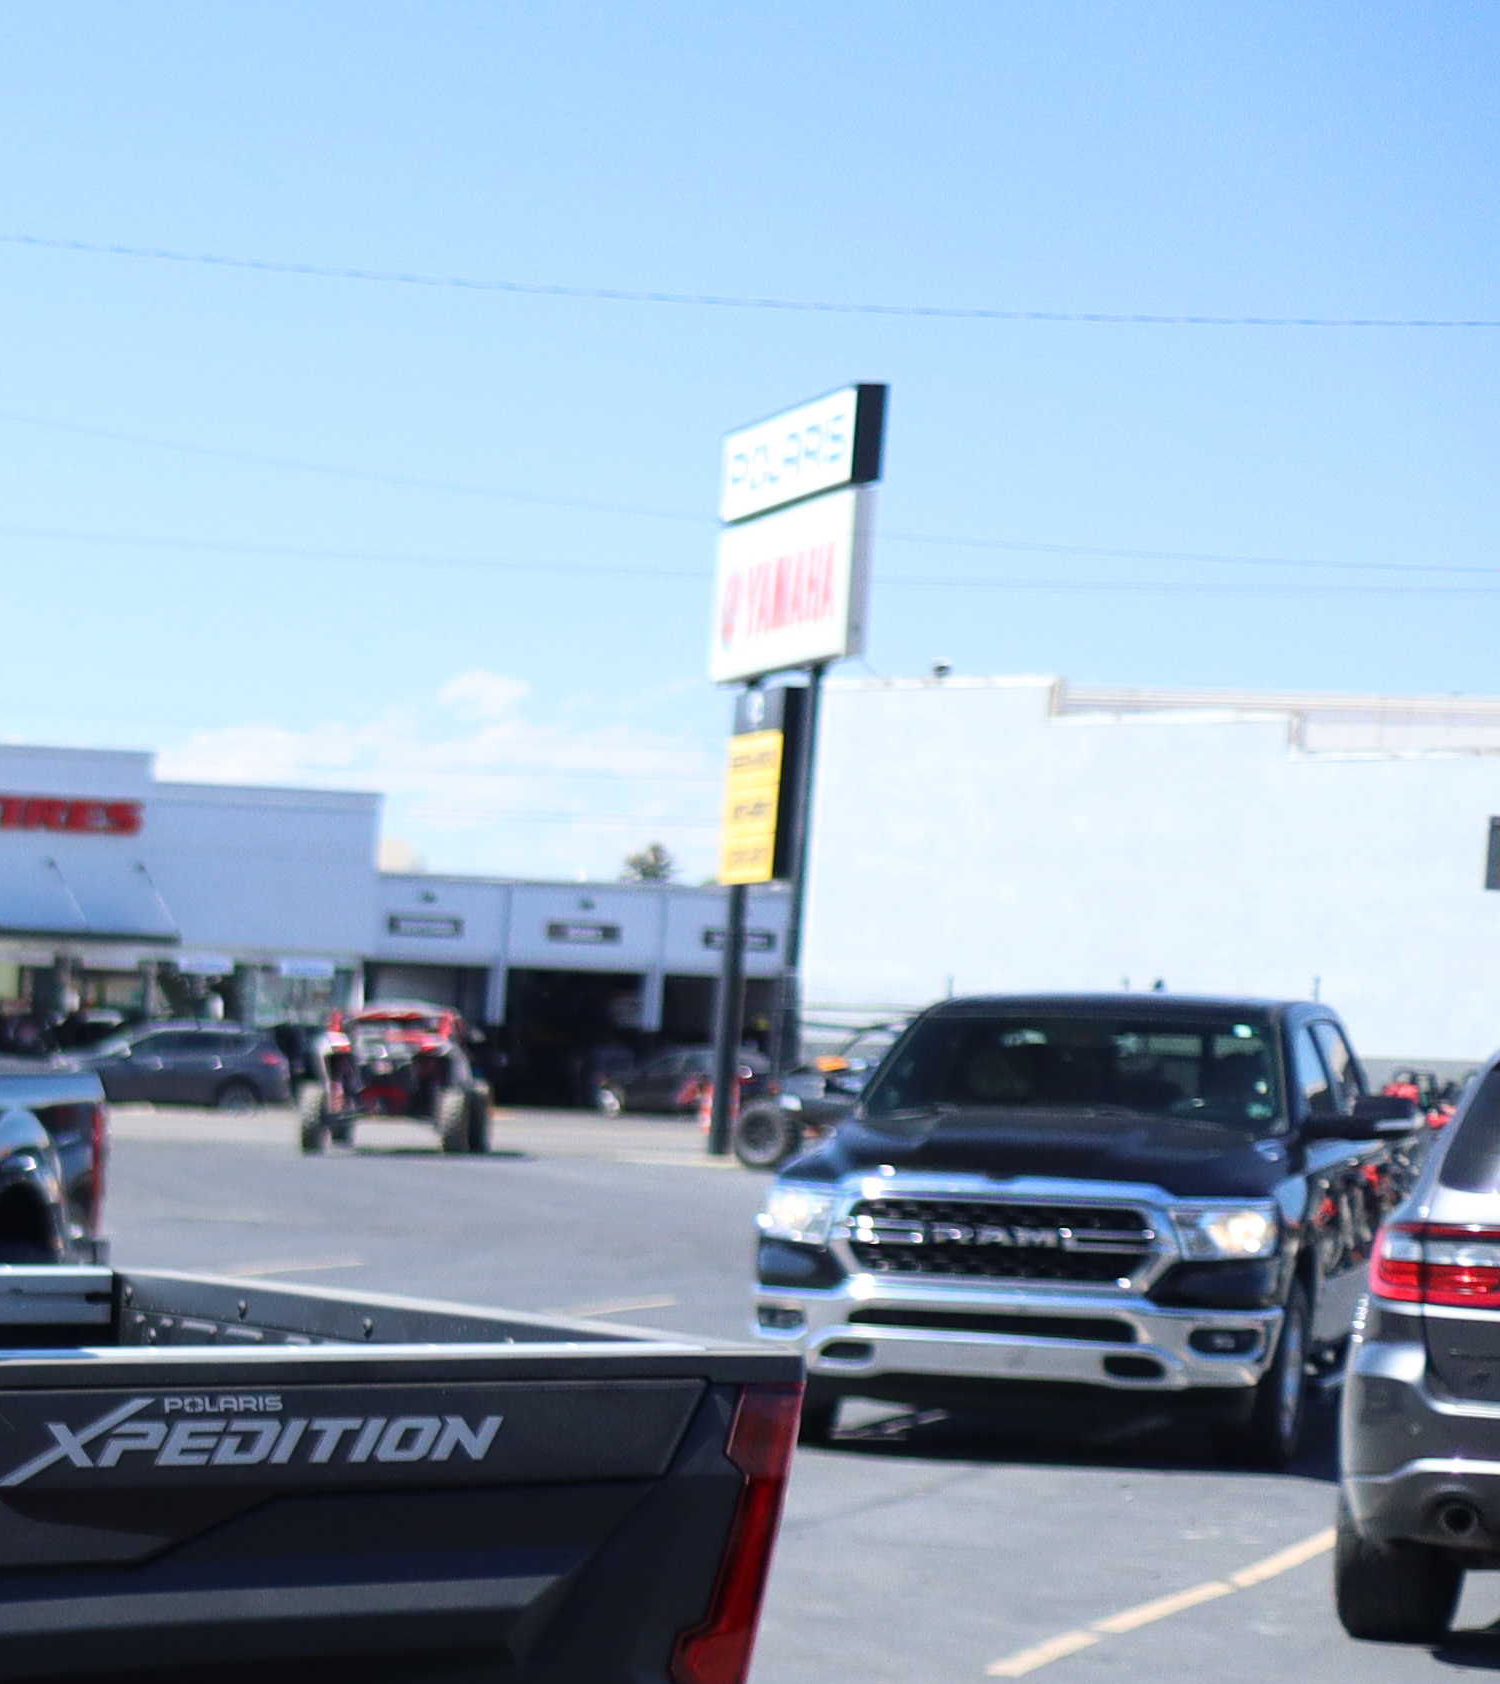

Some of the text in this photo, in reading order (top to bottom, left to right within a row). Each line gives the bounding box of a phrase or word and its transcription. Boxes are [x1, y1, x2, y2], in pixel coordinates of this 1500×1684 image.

[731, 413, 847, 491] POLARIS
[747, 541, 836, 640] YAMAHA
[929, 1221, 1060, 1250] RAM
[163, 1396, 283, 1413] POLARIS
